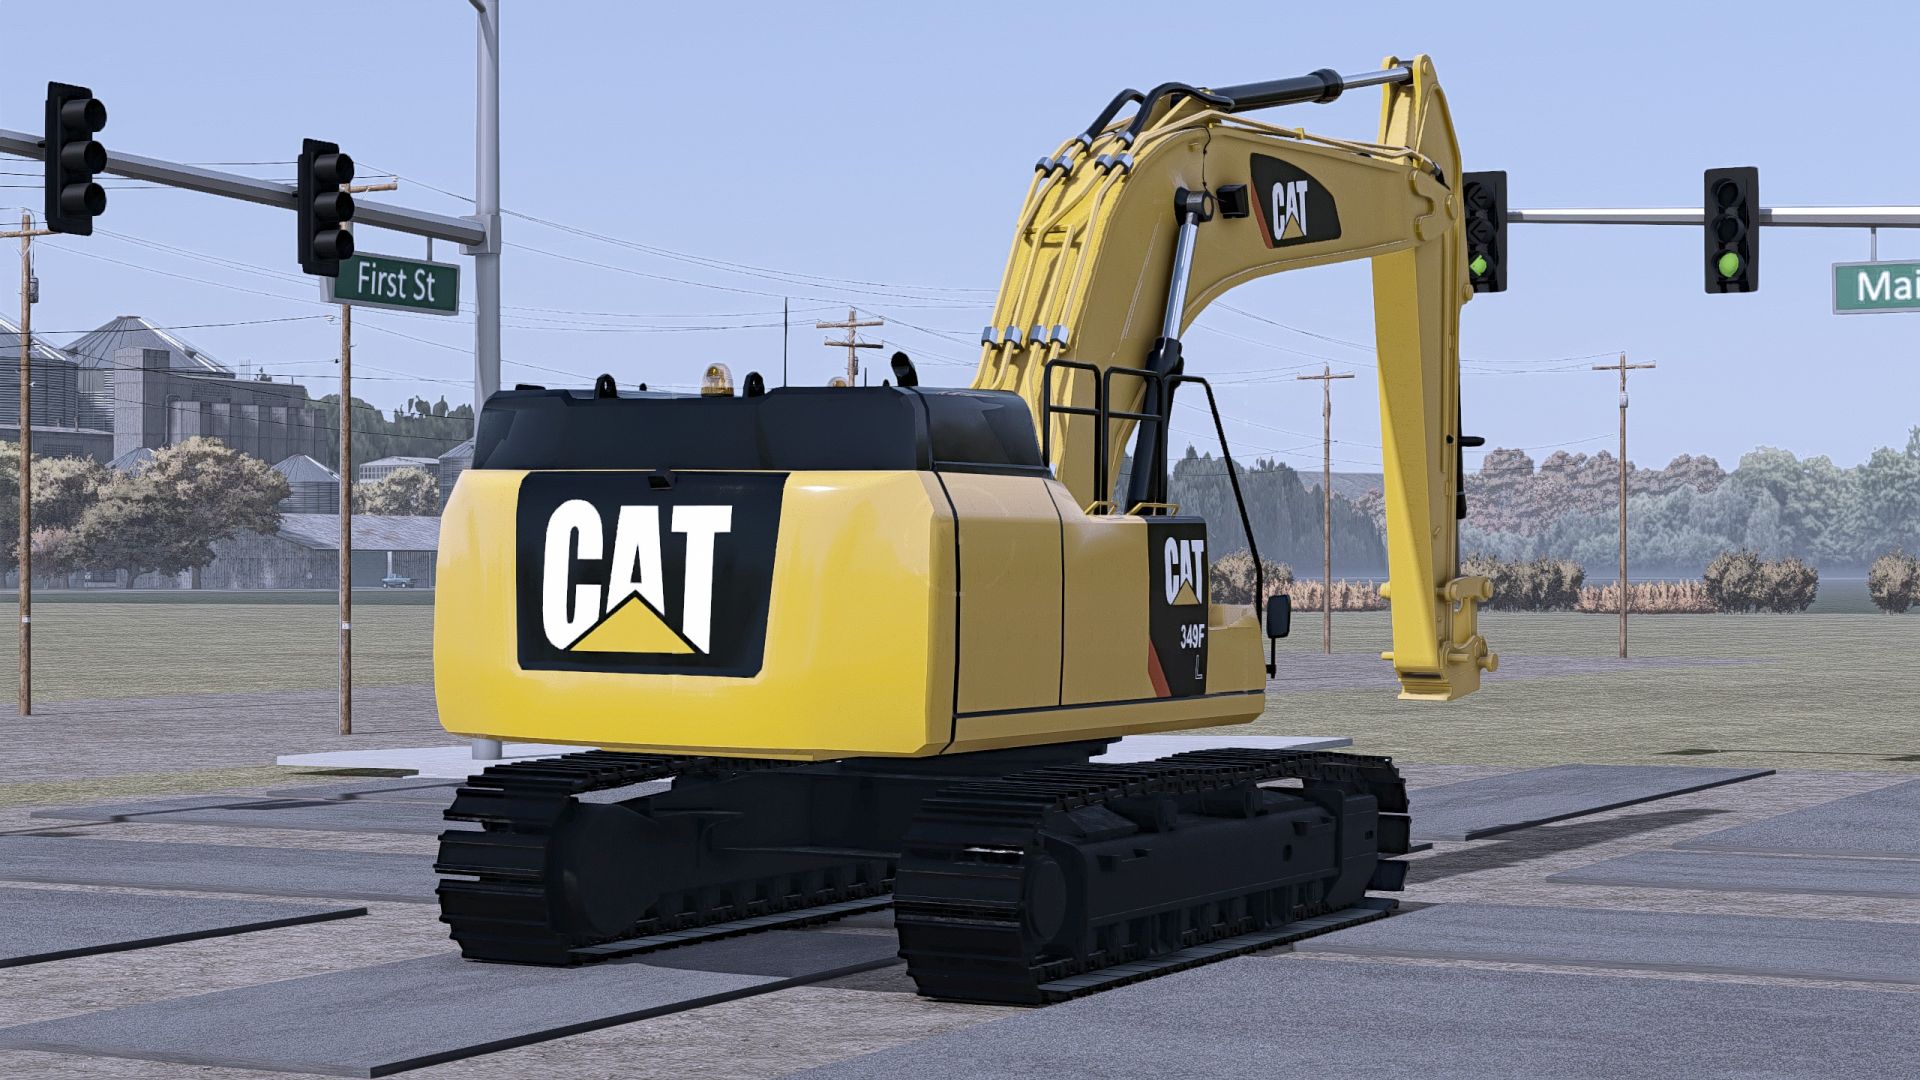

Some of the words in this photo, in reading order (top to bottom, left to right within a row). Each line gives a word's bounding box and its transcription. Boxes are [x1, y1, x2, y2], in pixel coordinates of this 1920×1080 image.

[1272, 180, 1308, 240] CAT
[358, 261, 407, 299] First
[413, 268, 436, 302] St
[542, 499, 733, 655] CAT
[1164, 536, 1205, 606] CAT
[1180, 623, 1205, 649] 349F
[1194, 654, 1203, 680] L
